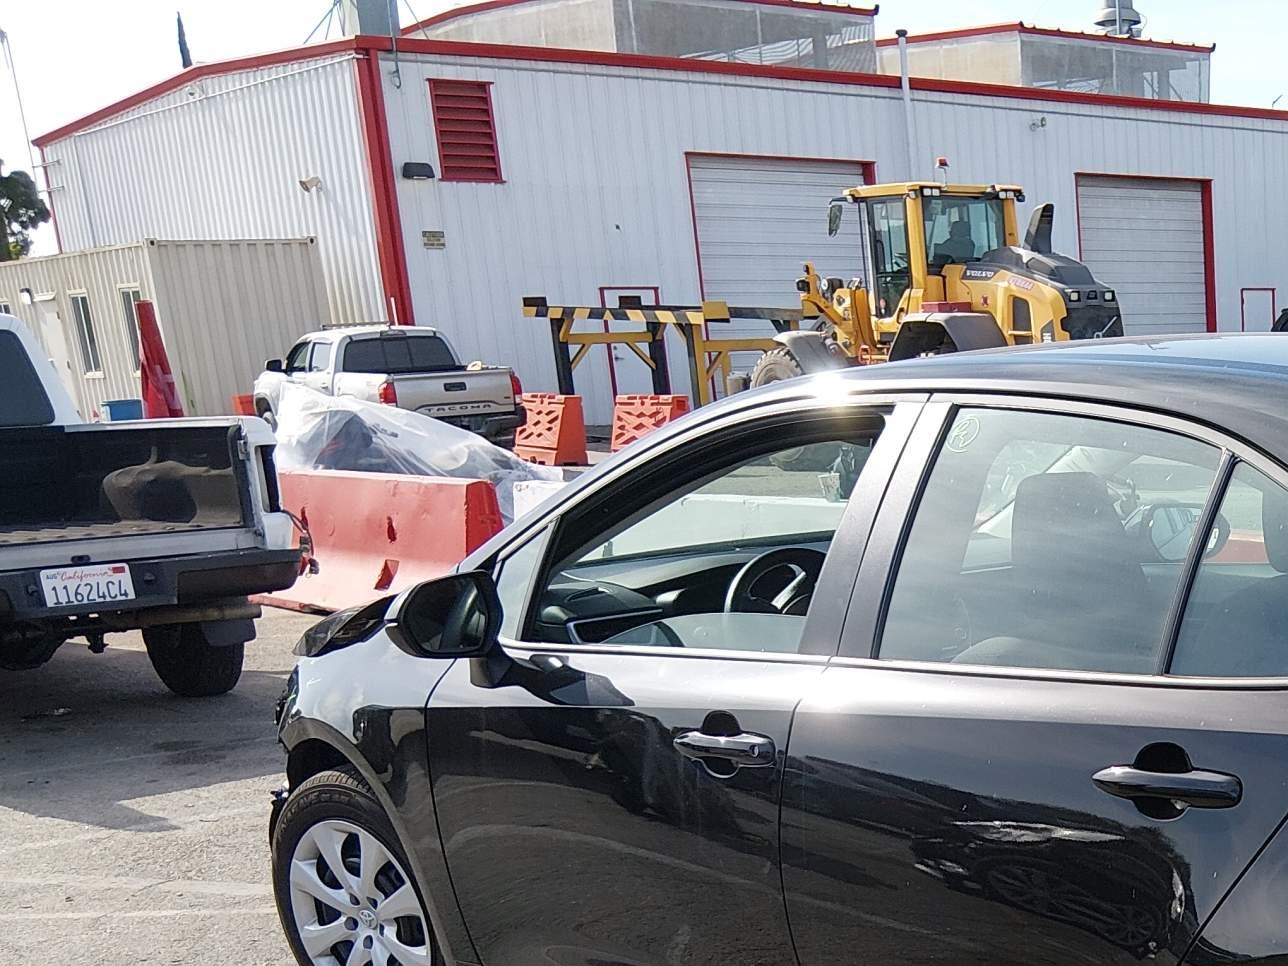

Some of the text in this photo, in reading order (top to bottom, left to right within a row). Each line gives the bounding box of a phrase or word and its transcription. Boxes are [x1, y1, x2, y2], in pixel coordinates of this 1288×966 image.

[966, 270, 995, 278] VOLVO
[424, 403, 492, 413] TACOMA
[61, 569, 110, 582] California
[51, 579, 129, 606] 11624C4
